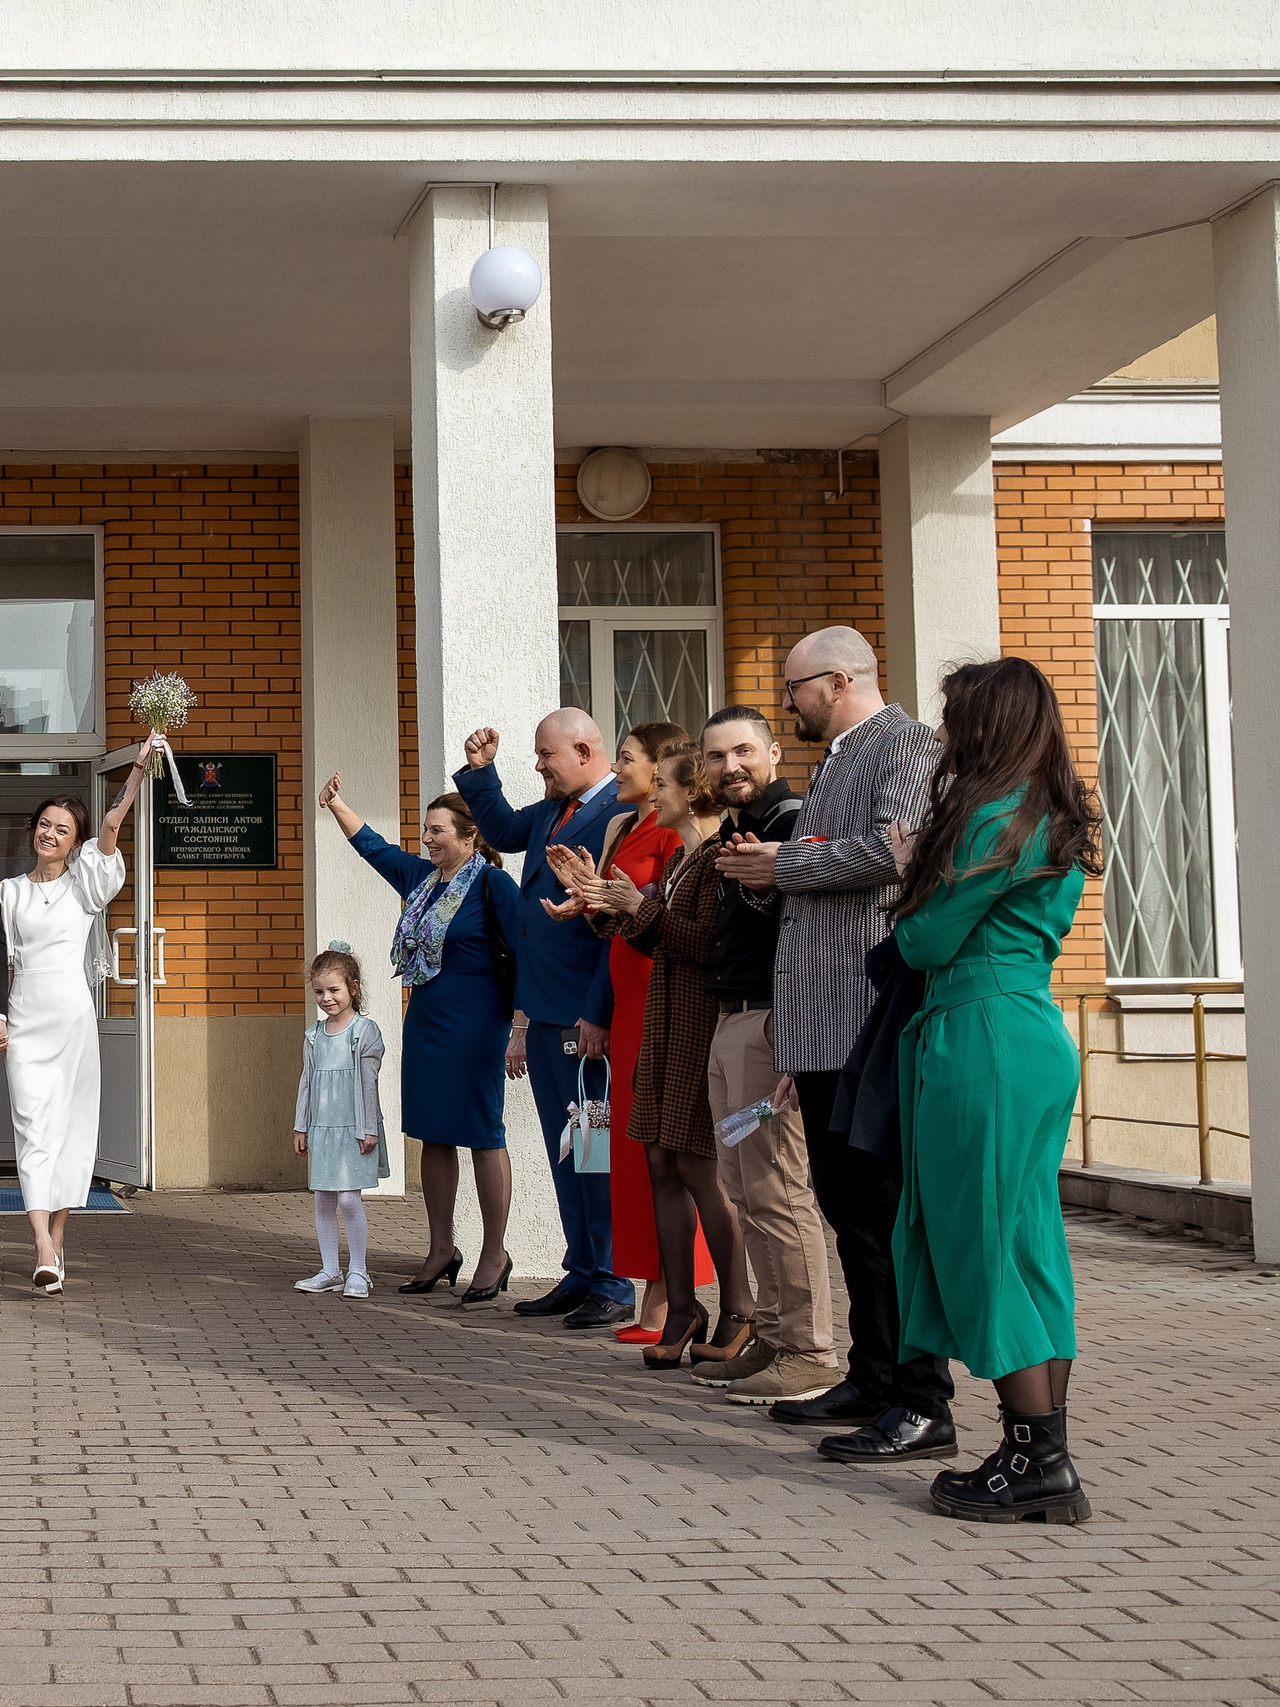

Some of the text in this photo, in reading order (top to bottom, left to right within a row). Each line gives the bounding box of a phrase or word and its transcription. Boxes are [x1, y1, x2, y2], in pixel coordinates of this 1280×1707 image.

[158, 816, 263, 825] ОТДЕЛ ЗАПИСИ АКТОВ
[174, 826, 248, 834] ГРАЖДАНСКОГО
[183, 835, 238, 843] СОСТОЯНИЯ
